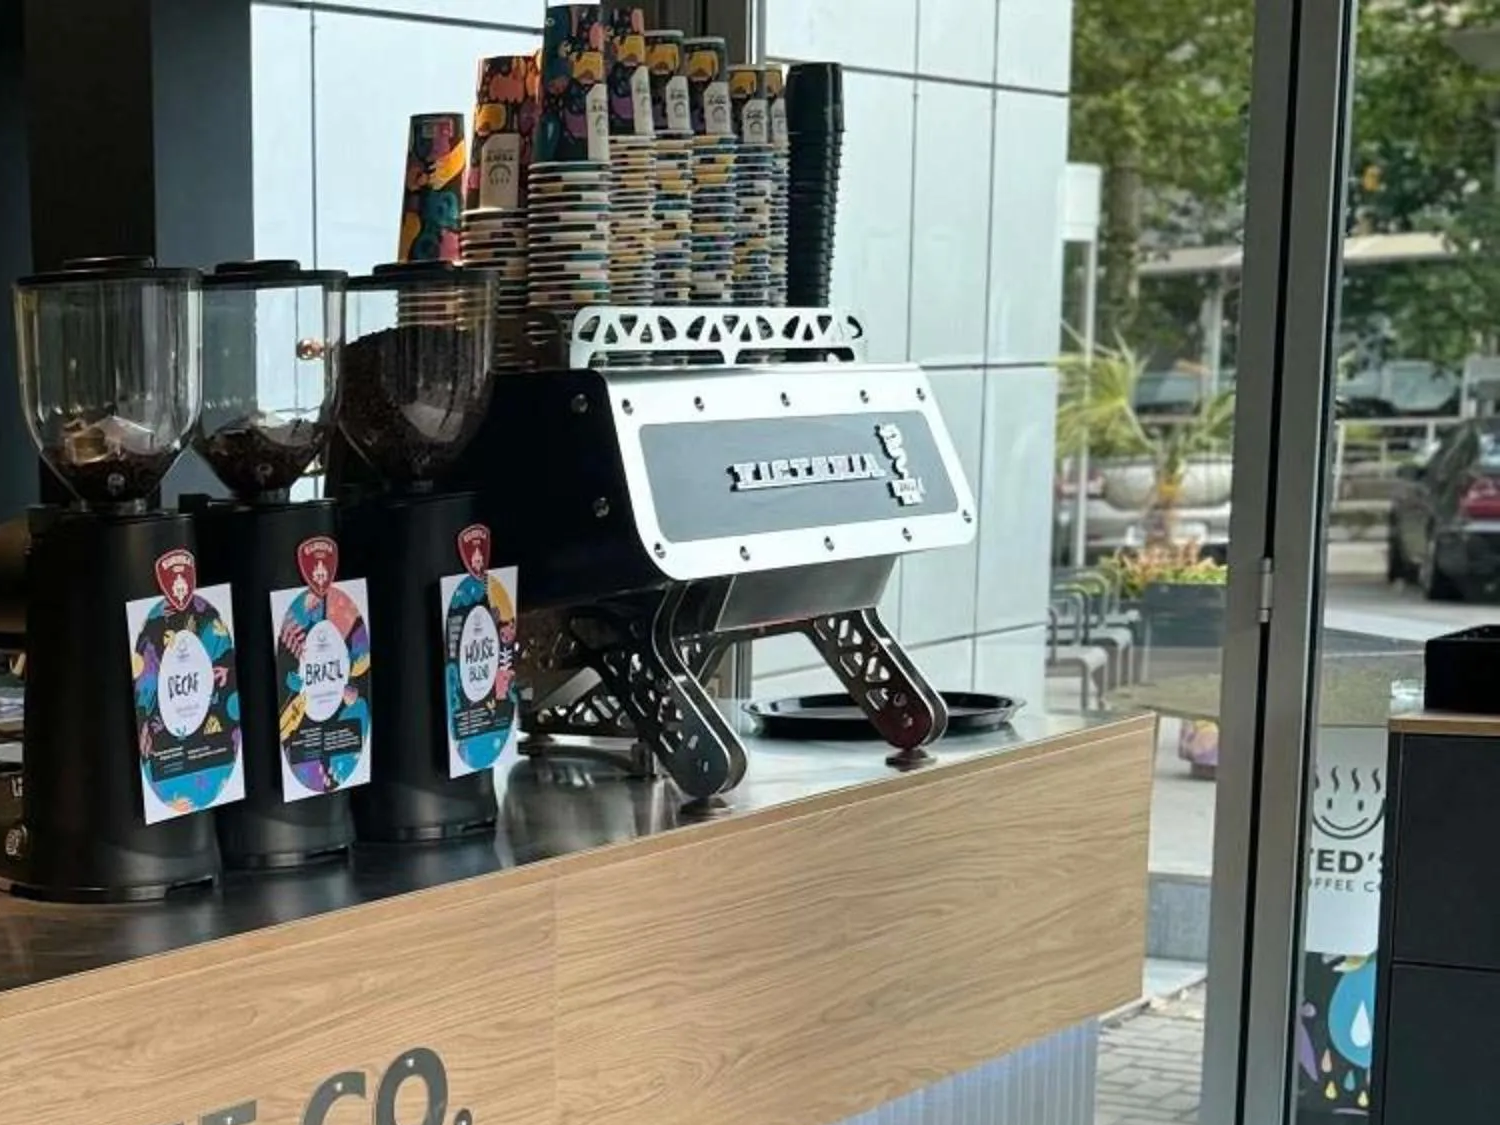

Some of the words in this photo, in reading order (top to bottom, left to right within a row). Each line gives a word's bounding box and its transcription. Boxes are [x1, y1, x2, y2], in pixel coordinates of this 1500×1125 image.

[465, 636, 495, 665] HOUSE
[305, 659, 344, 686] BRAZIL
[1310, 847, 1382, 875] ED'
[1363, 881, 1381, 893] C
